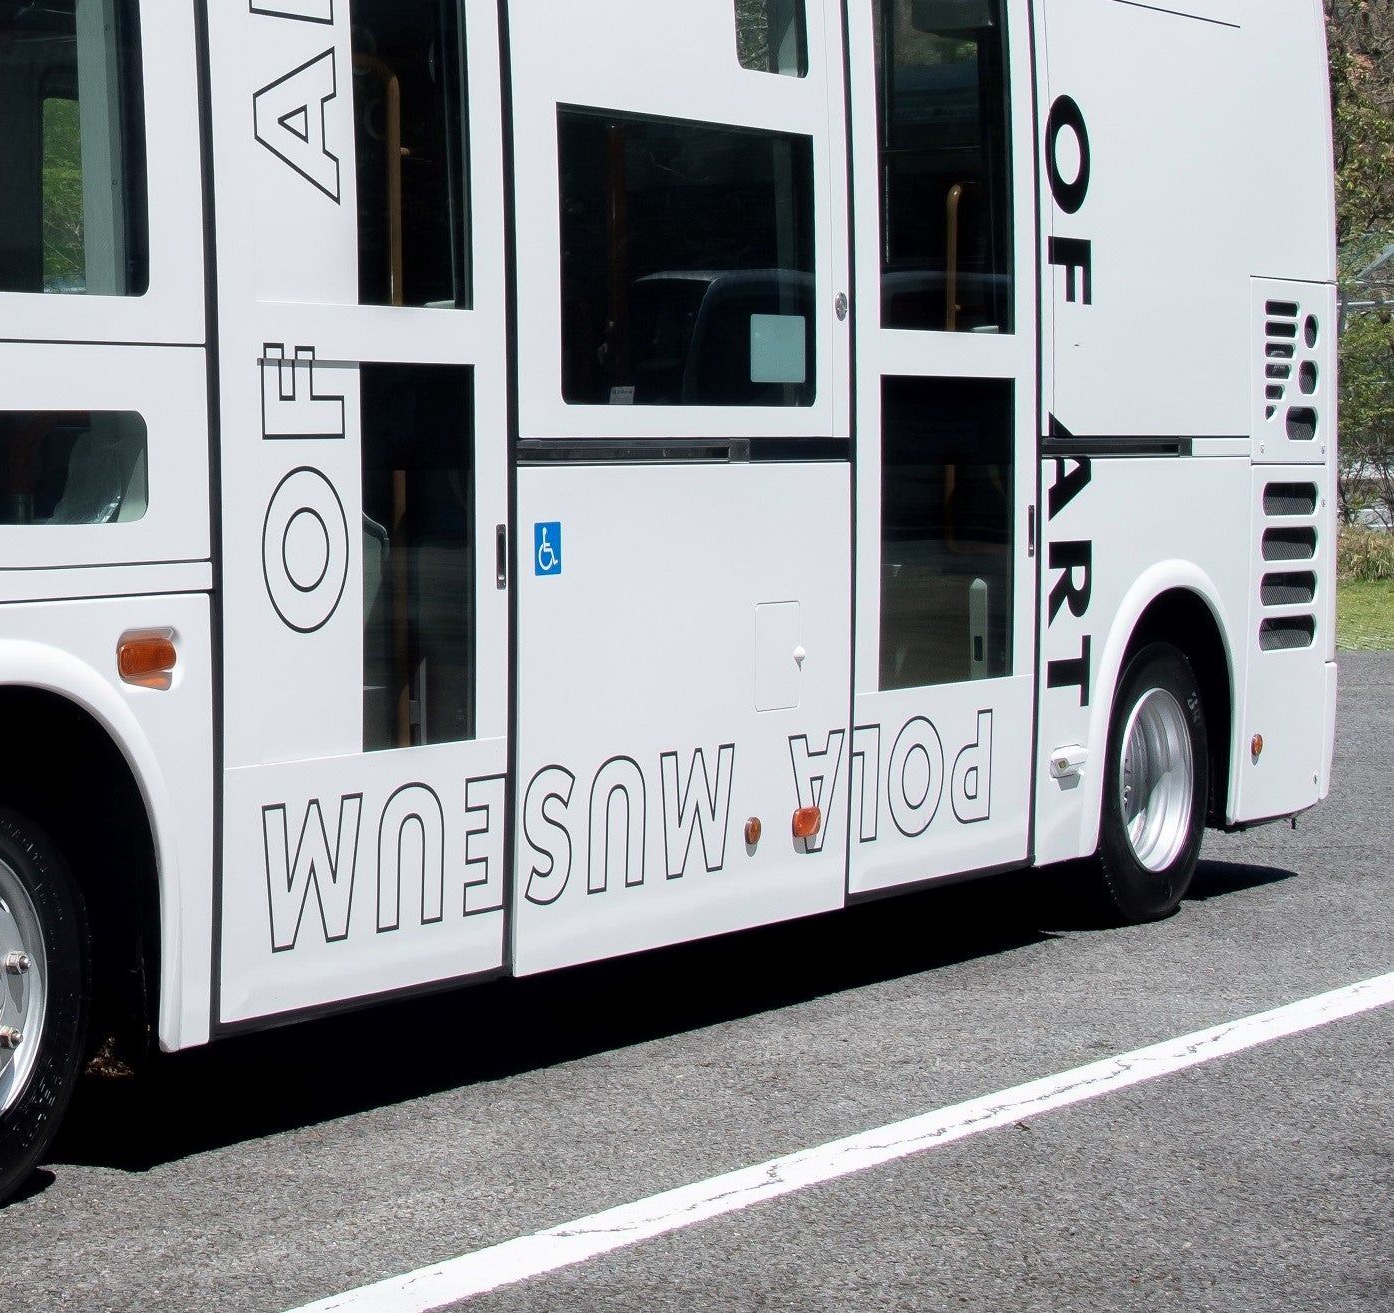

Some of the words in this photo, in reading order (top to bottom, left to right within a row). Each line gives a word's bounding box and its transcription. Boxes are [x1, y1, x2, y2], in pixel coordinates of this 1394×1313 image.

[1046, 94, 1092, 306] OF
[261, 342, 349, 634] OF
[1046, 410, 1093, 707] ART
[261, 742, 736, 953] MUSEUM
[788, 707, 994, 855] POLA
